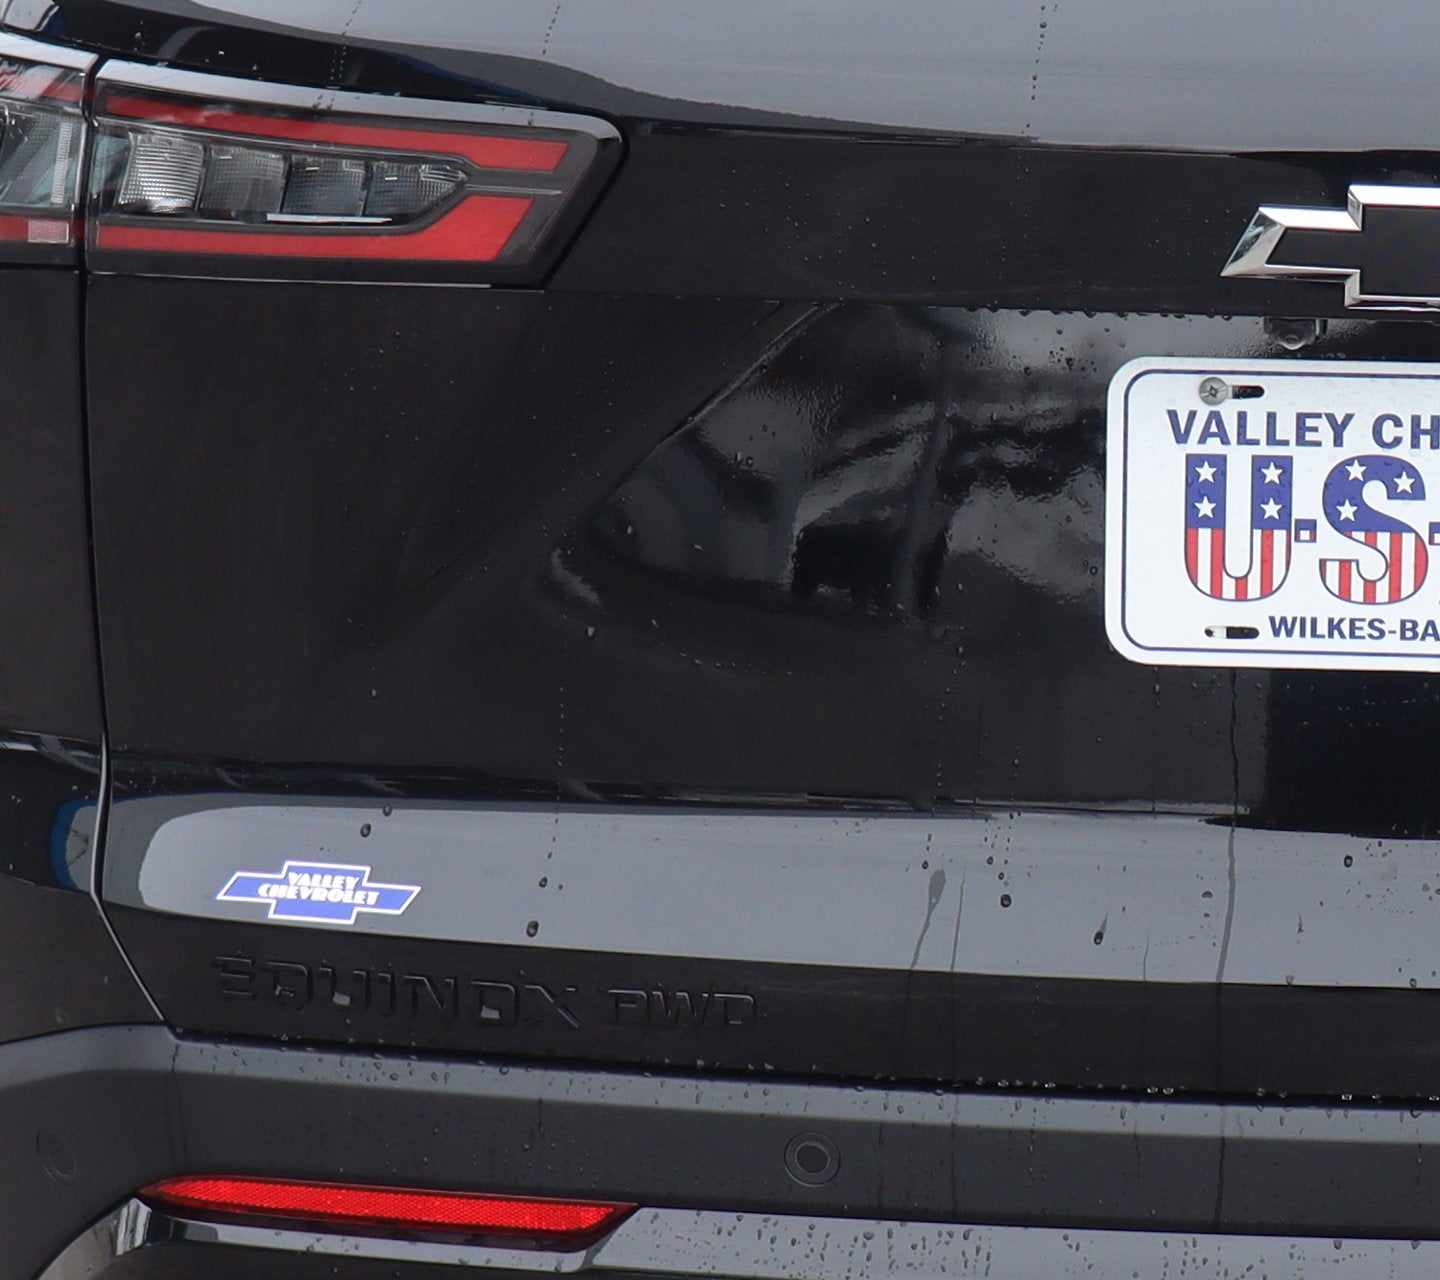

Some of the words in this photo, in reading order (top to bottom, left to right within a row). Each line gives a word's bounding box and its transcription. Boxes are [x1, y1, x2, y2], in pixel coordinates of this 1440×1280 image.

[1165, 408, 1357, 450] VALLEY
[257, 883, 380, 906] CHEVROLET
[287, 871, 360, 889] VALLEY
[210, 954, 580, 1028] EQUINOX
